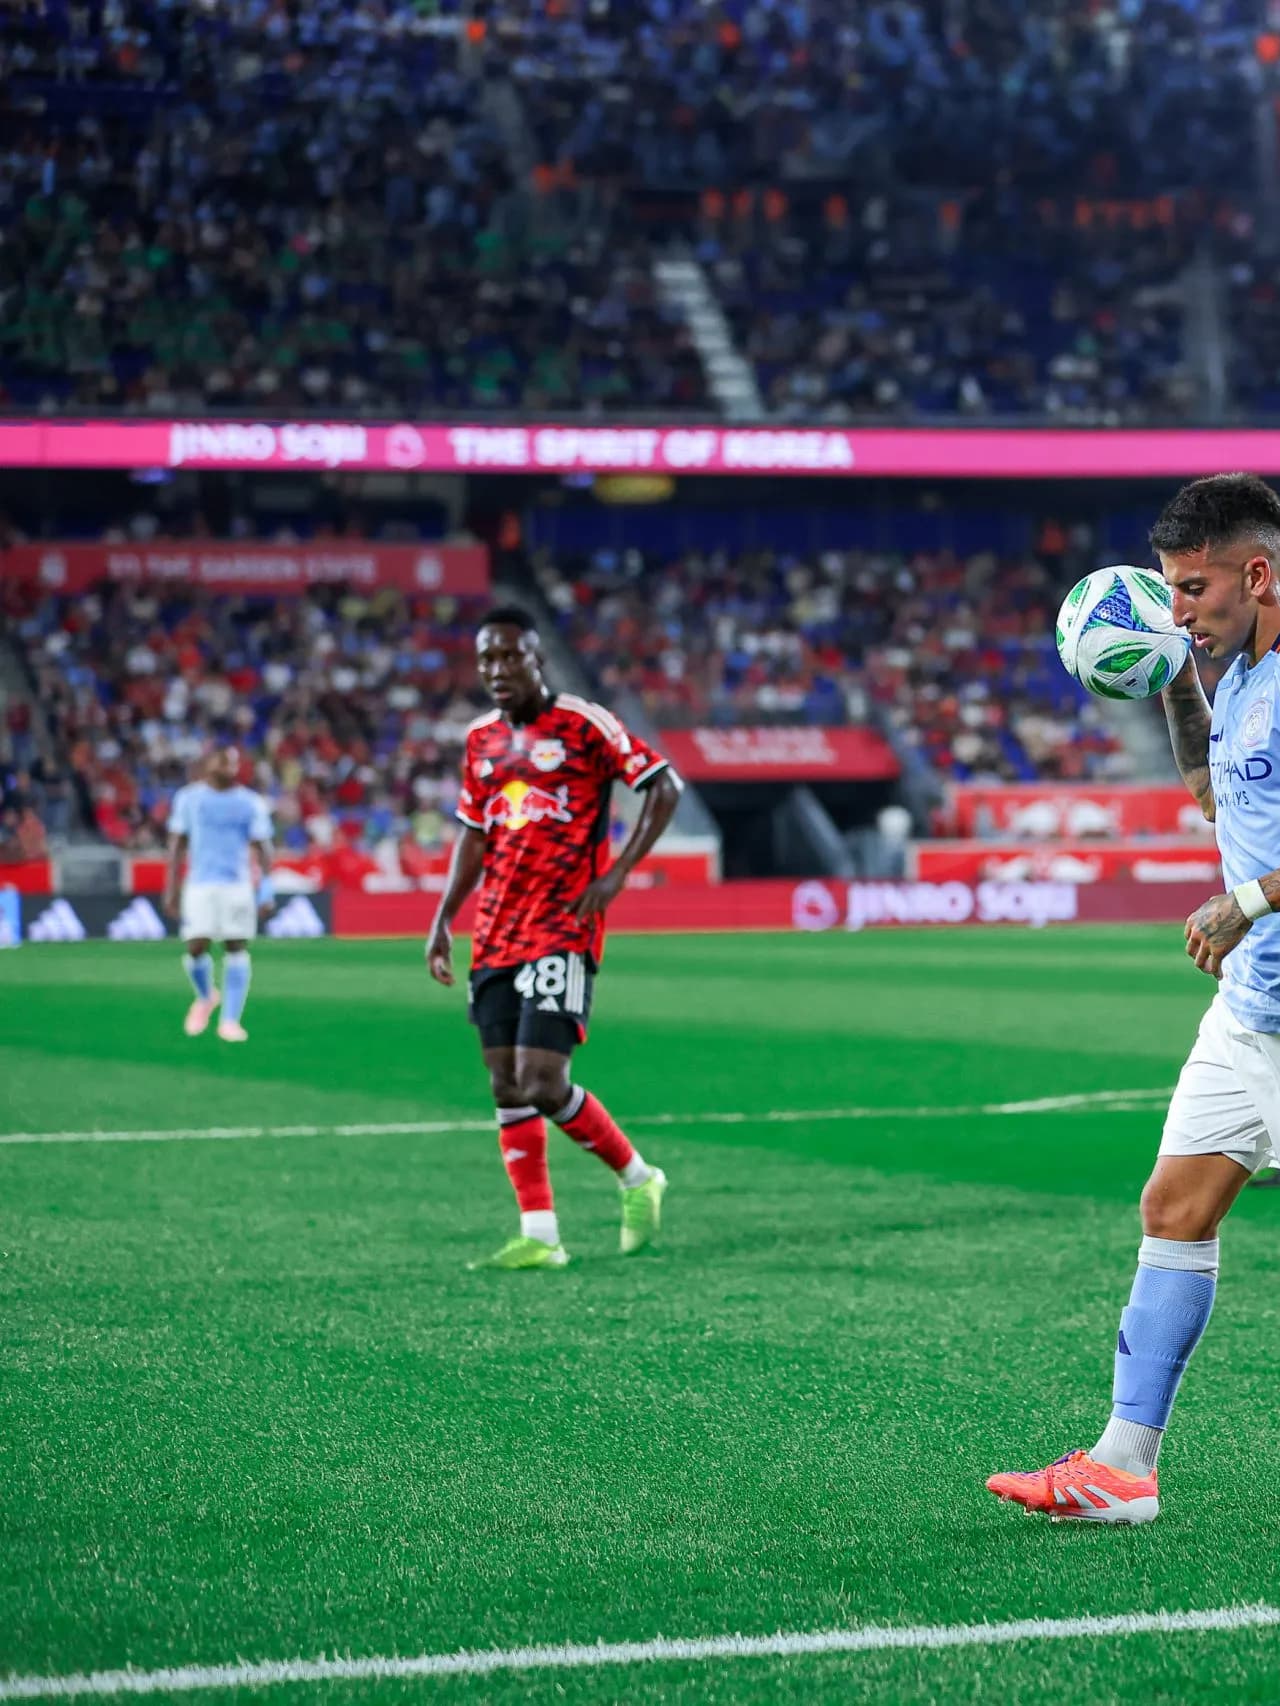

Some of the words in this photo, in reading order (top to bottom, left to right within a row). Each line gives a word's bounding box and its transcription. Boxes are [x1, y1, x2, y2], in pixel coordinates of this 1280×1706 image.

[169, 423, 276, 467] JINRO
[448, 428, 528, 466] THE
[533, 429, 659, 467] SPIRIT
[662, 430, 717, 468] OF
[722, 431, 853, 468] KOREA
[847, 881, 973, 932] JINRO
[513, 954, 567, 999] 48
